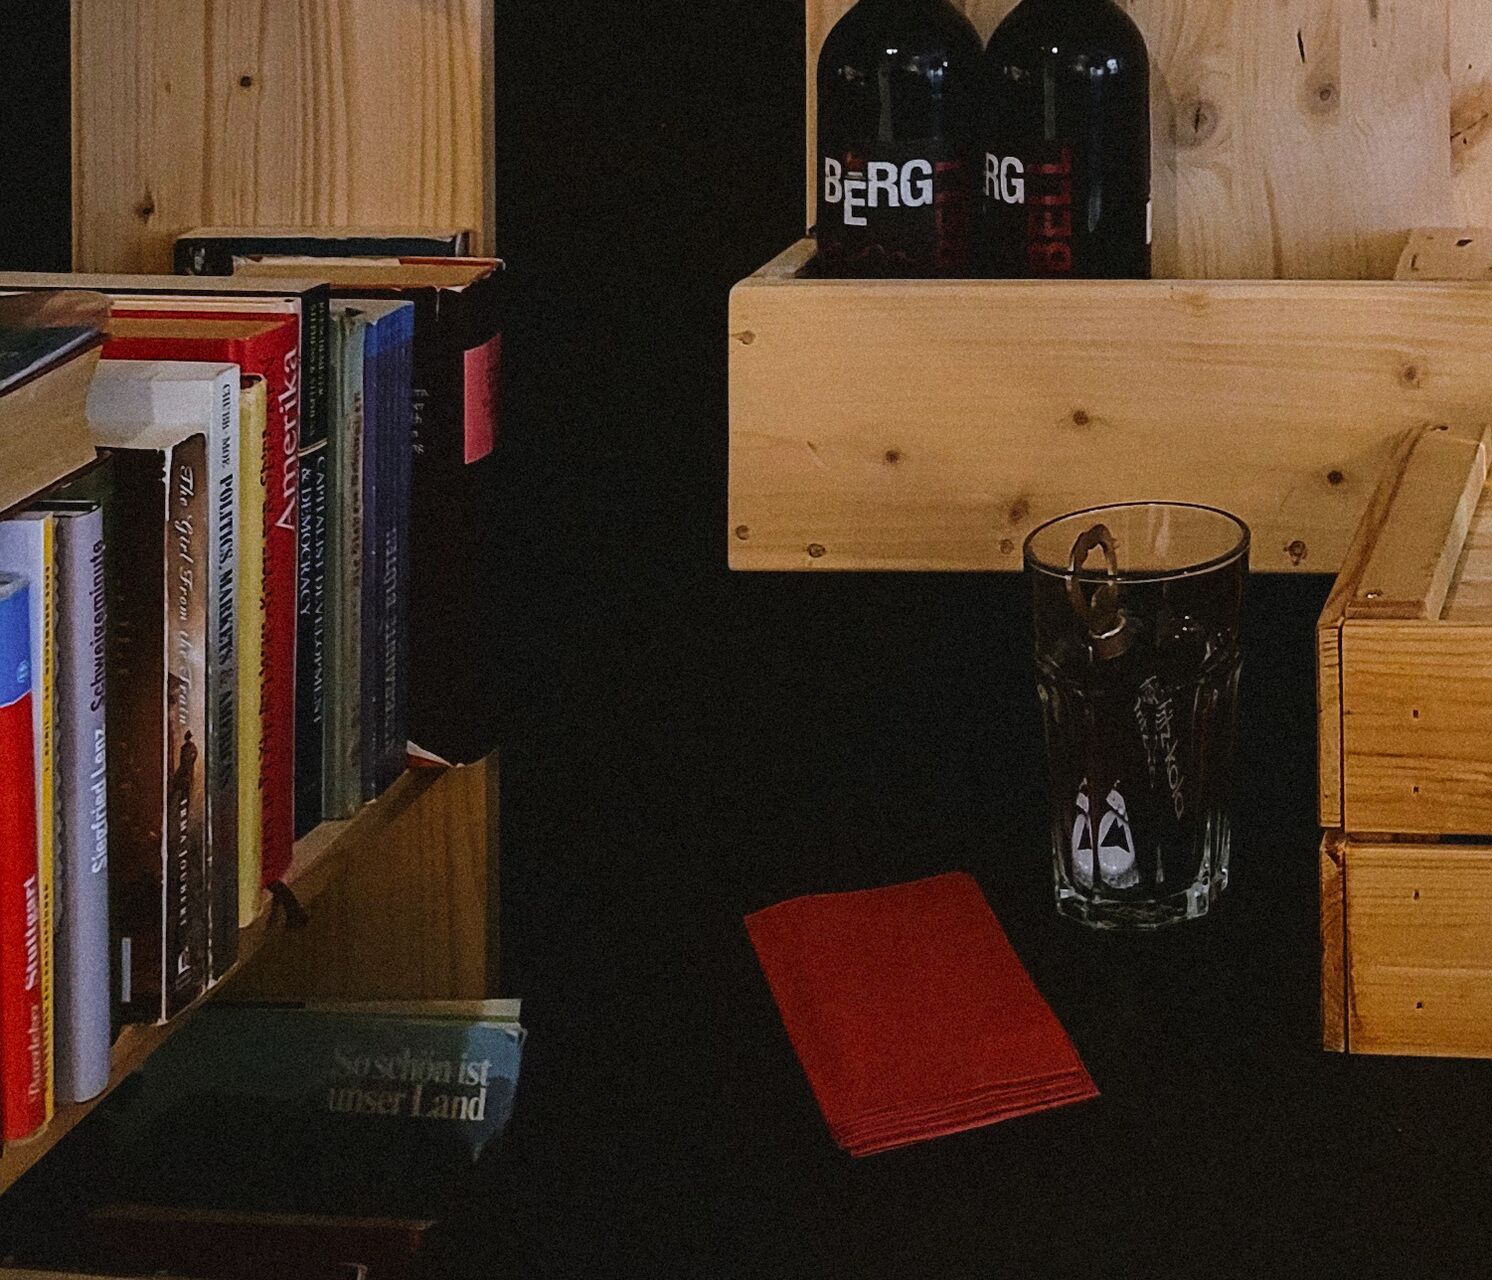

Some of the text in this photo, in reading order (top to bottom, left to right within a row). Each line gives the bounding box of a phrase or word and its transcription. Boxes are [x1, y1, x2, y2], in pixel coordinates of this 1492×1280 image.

[825, 157, 933, 226] BERG
[275, 347, 298, 531] Amerika
[173, 464, 194, 726] The Girl From the Train
[218, 473, 234, 666] POLITICS, MARKETS
[300, 488, 312, 616] DEMOCRACY
[313, 455, 325, 723] CAPITALIST DEVELOPMENT
[90, 538, 107, 779] Lenz Schweigeminute
[410, 1085, 487, 1121] Land
[458, 1053, 492, 1086] ist
